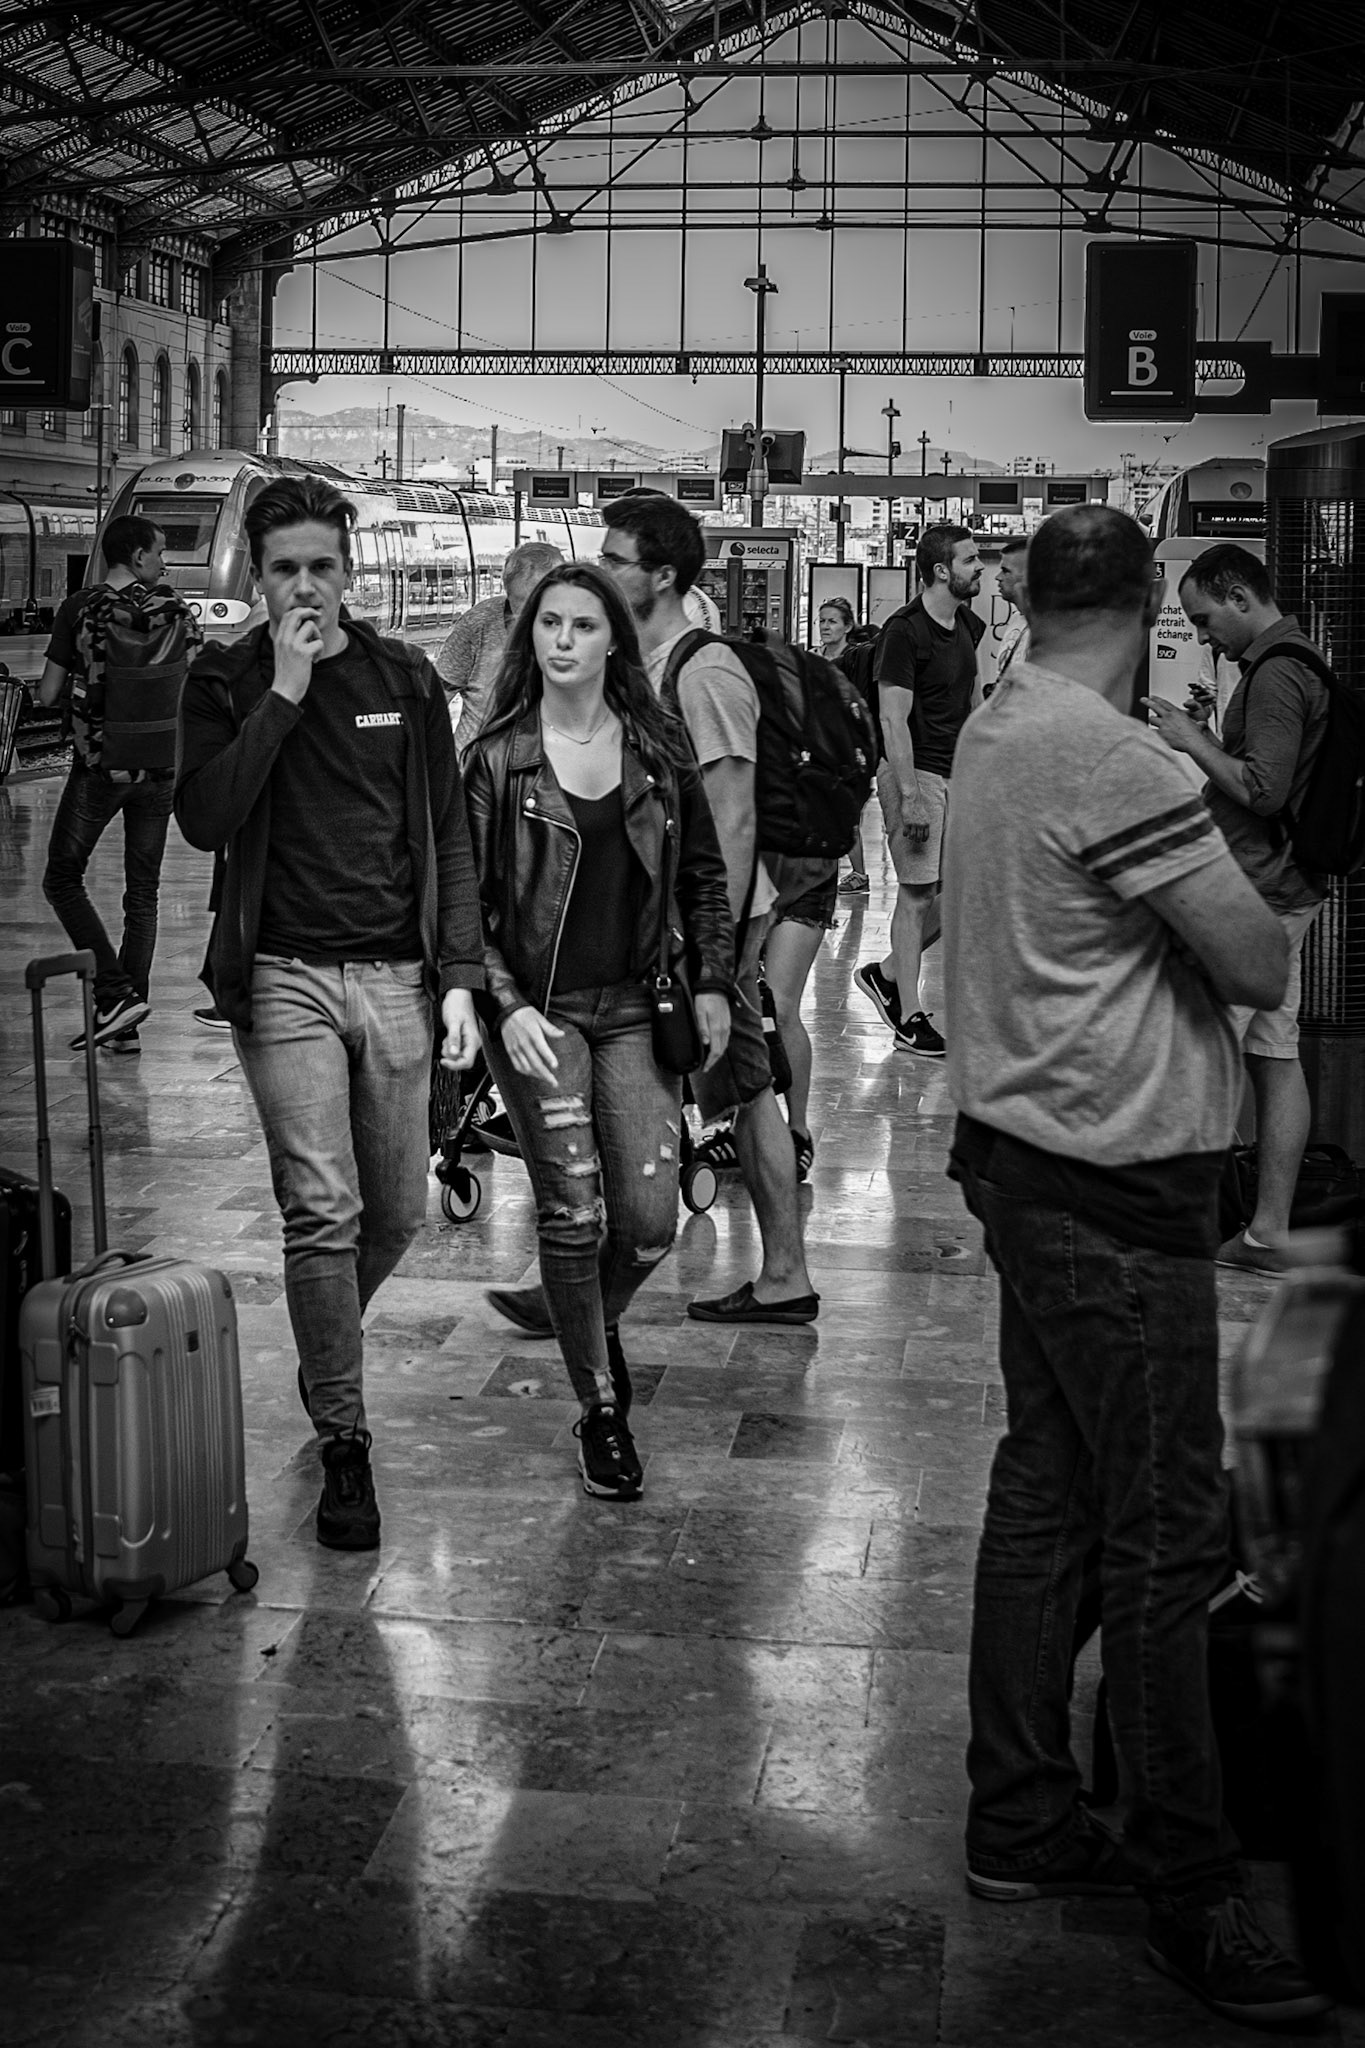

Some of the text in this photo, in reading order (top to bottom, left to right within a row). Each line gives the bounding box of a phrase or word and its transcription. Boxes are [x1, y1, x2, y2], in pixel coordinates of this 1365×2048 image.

[1132, 331, 1153, 339] Voie
[2, 338, 32, 375] C
[1128, 346, 1157, 386] B
[904, 526, 915, 540] Z
[747, 546, 779, 555] selecta
[1157, 618, 1185, 627] retrait
[1157, 628, 1193, 642] échange
[1158, 650, 1176, 658] SNCF
